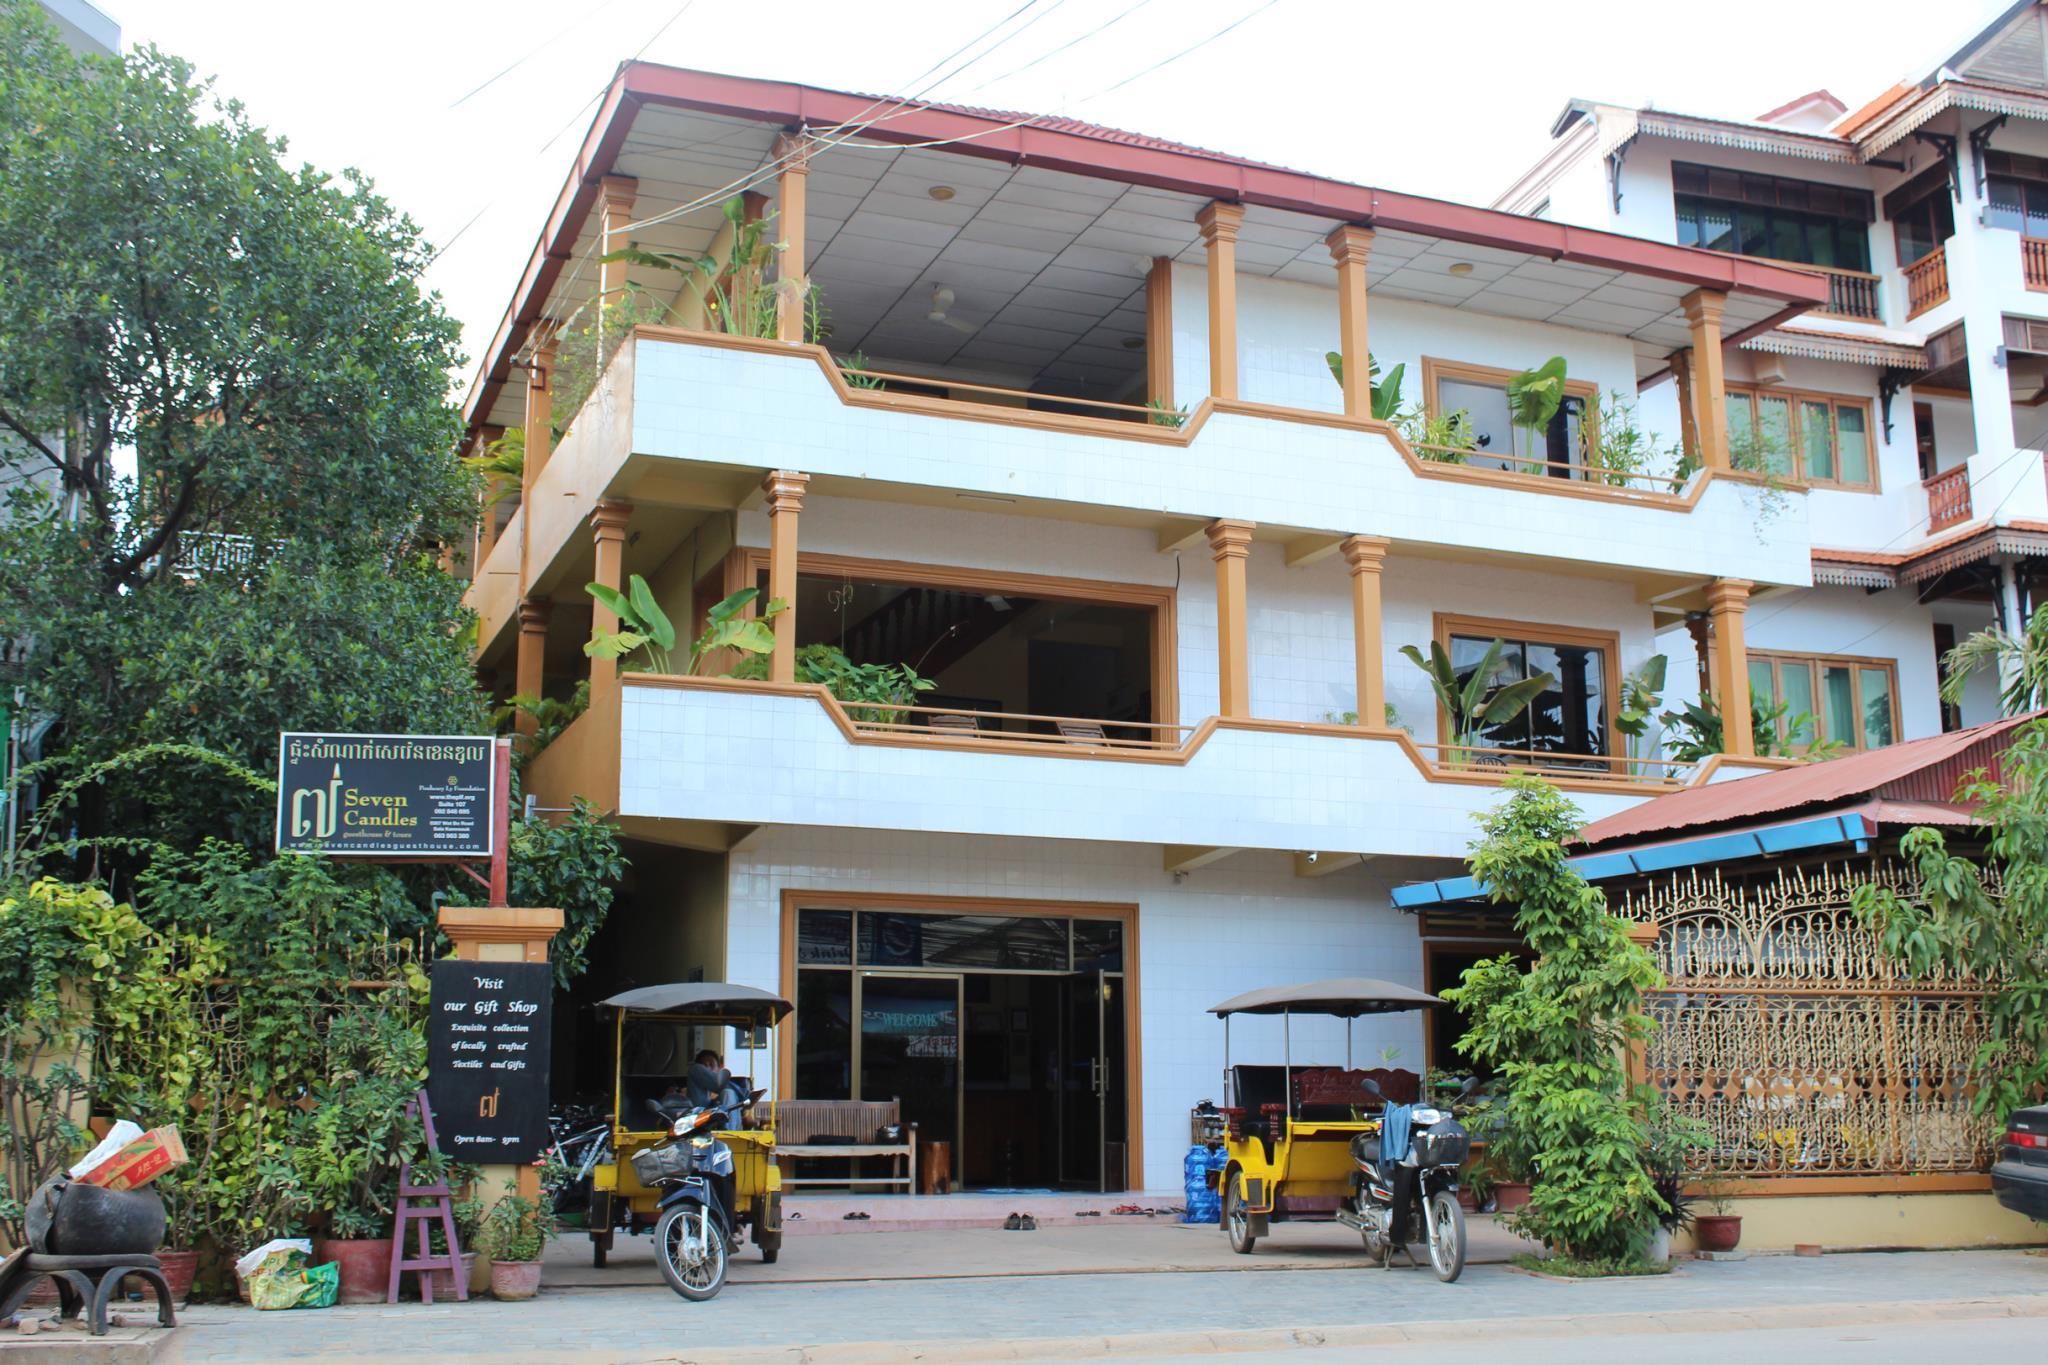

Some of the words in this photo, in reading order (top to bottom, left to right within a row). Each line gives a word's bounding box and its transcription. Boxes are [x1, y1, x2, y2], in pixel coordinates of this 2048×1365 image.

[344, 788, 408, 807] Seven
[343, 808, 418, 826] Candles
[384, 830, 392, 838] &
[473, 976, 504, 990] Visit
[443, 1002, 467, 1011] our
[474, 1000, 499, 1016] Gift
[507, 1000, 538, 1017] Shop
[883, 1013, 937, 1027] WELCOME
[451, 1023, 487, 1033] Exquisite
[492, 1023, 529, 1032] collection
[451, 1041, 461, 1052] of
[461, 1041, 487, 1052] locally
[497, 1042, 528, 1052] crafted
[452, 1060, 483, 1069] Textiles
[490, 1060, 507, 1069] and
[507, 1060, 526, 1071] Gifts
[454, 1135, 475, 1145] Open
